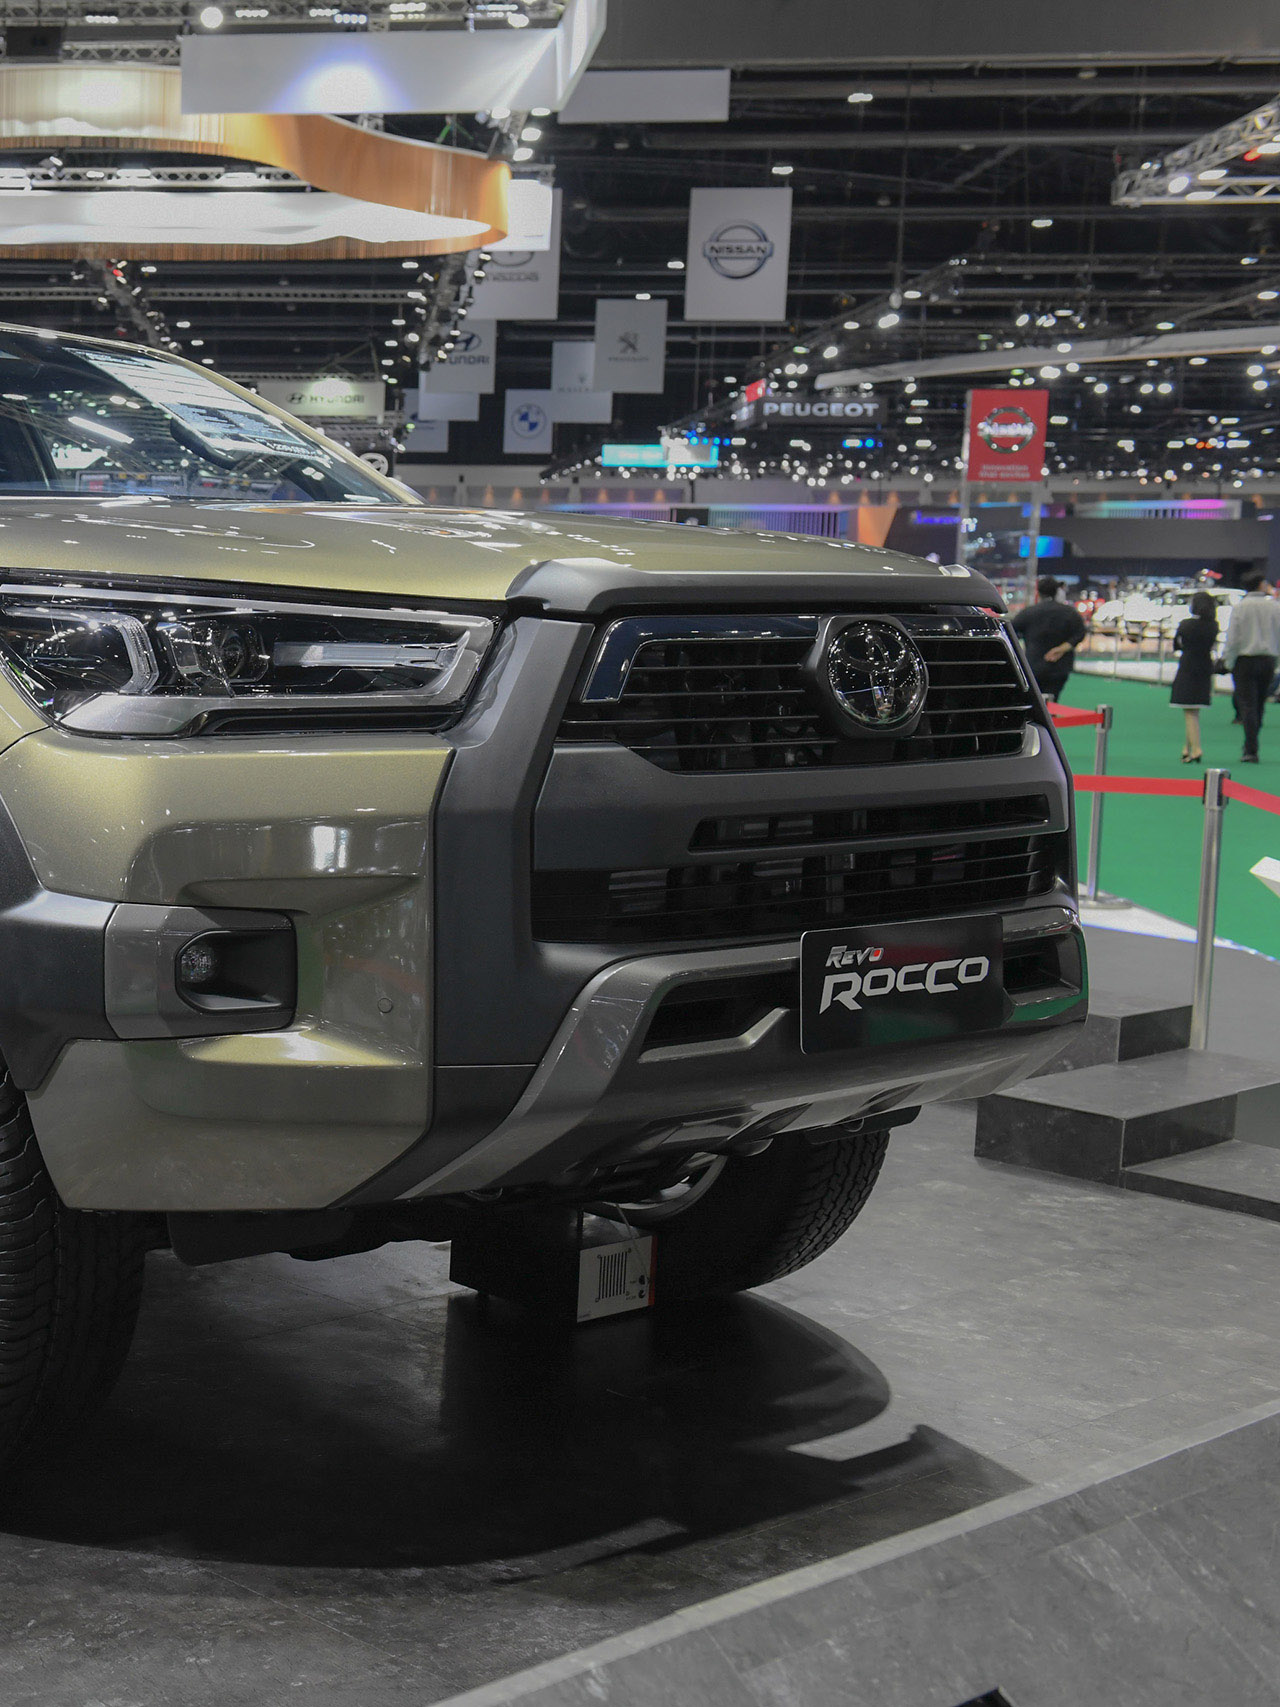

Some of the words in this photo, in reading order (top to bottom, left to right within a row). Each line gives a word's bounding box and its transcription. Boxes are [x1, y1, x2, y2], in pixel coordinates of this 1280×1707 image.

[710, 245, 767, 255] NISSAN
[763, 402, 880, 417] PEUGEOT
[819, 956, 990, 1015] ROCCO
